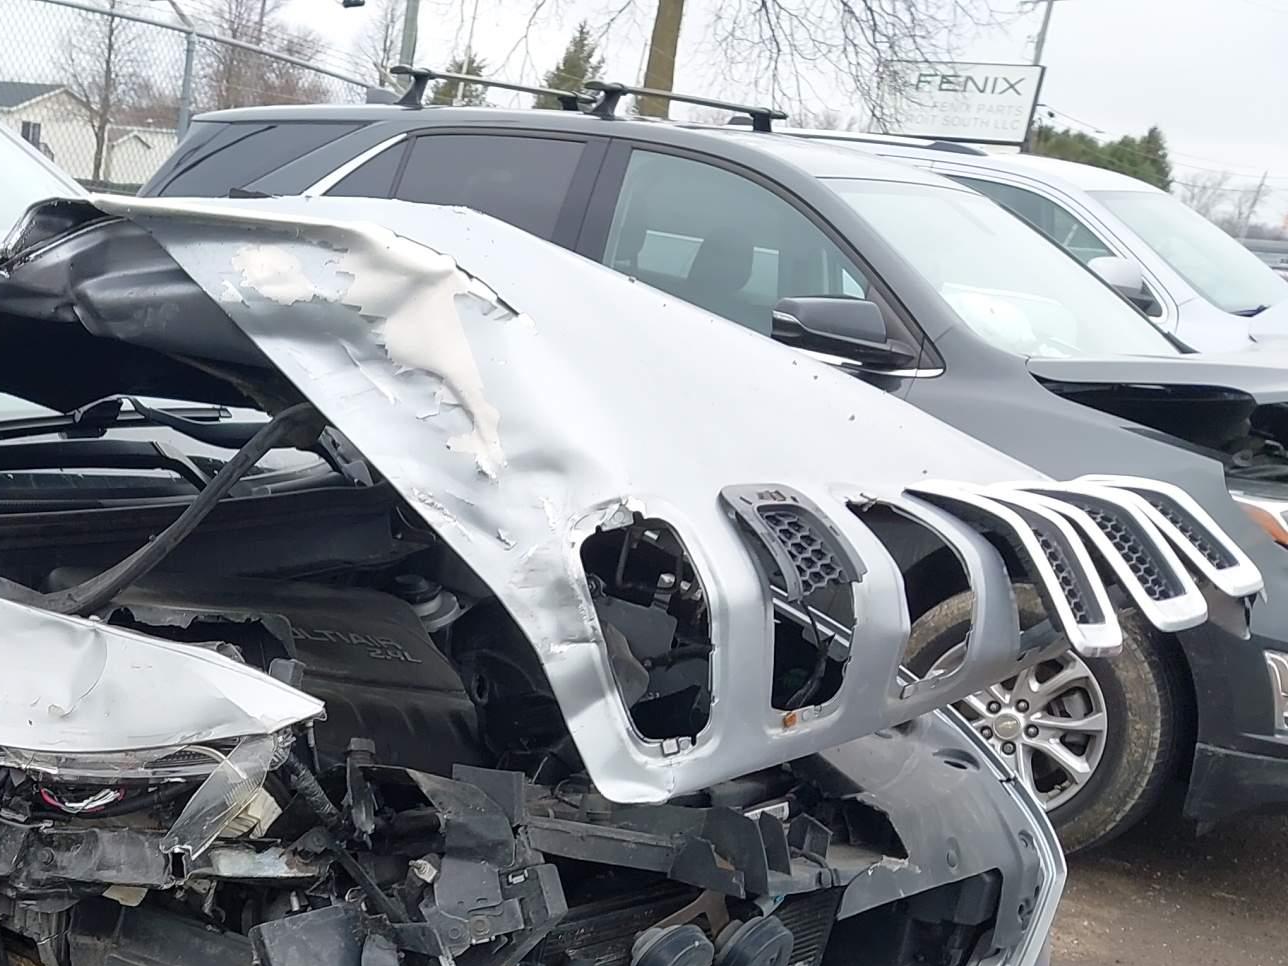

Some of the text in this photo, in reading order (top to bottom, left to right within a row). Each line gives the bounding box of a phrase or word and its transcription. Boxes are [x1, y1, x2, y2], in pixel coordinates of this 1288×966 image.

[915, 73, 1027, 97] FENIX
[976, 103, 1024, 117] PARTS
[941, 114, 990, 128] SOUTH
[994, 118, 1021, 131] LLC
